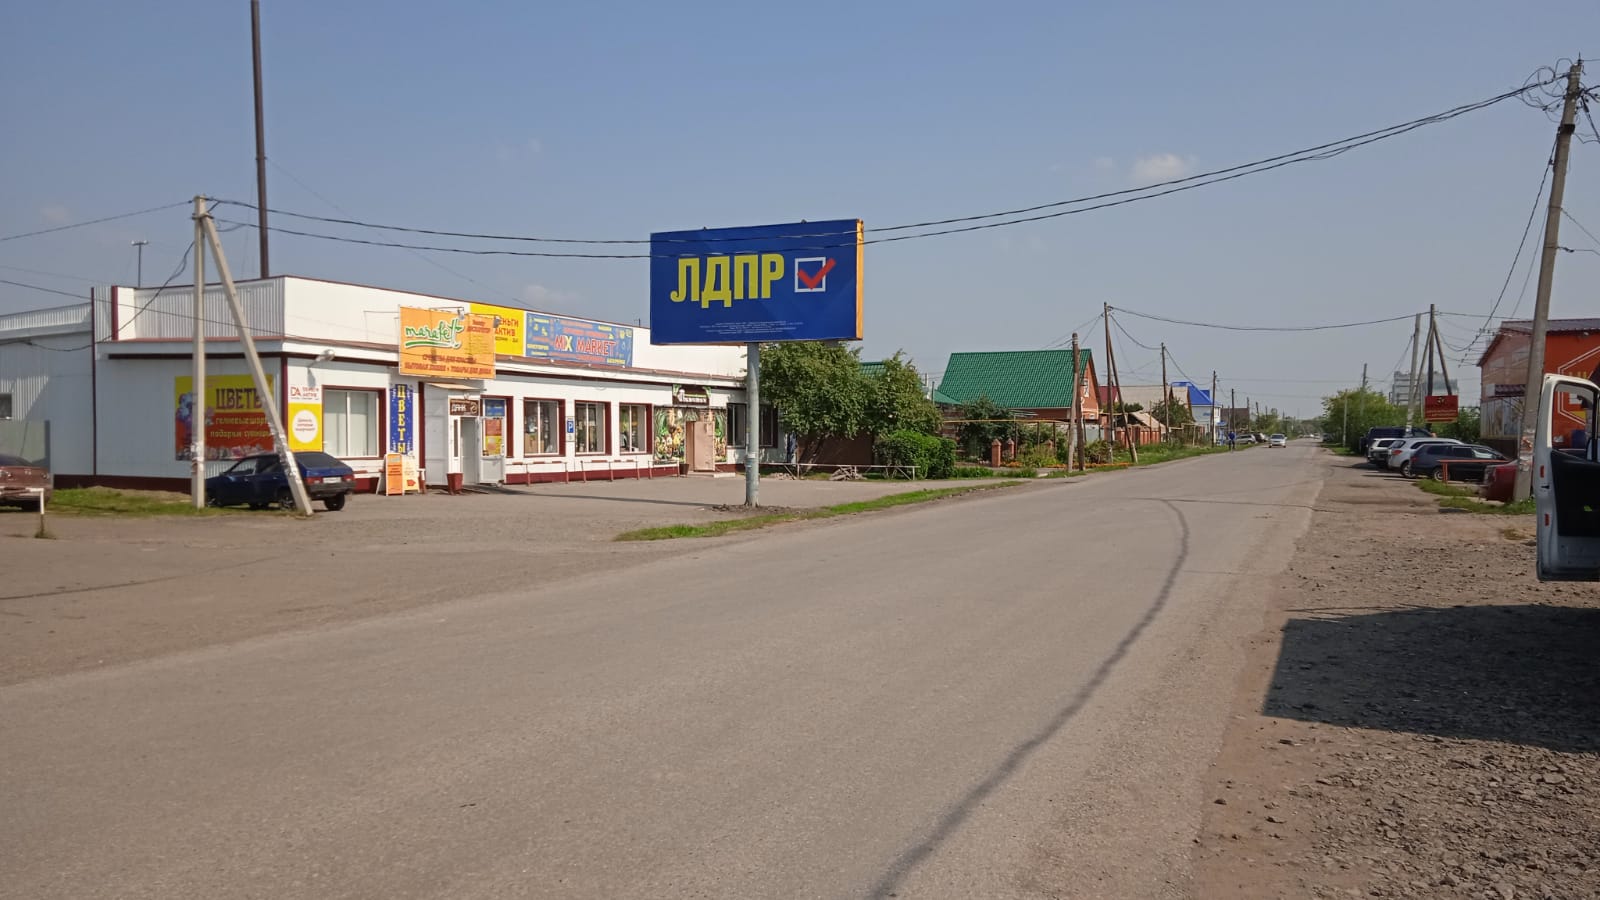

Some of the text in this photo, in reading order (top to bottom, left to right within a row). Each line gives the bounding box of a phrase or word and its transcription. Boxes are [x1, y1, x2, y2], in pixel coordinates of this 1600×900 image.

[670, 254, 784, 308] ЛДПР
[554, 335, 617, 356] MIX MARKET
[397, 385, 406, 453] ЦВЕТЫ
